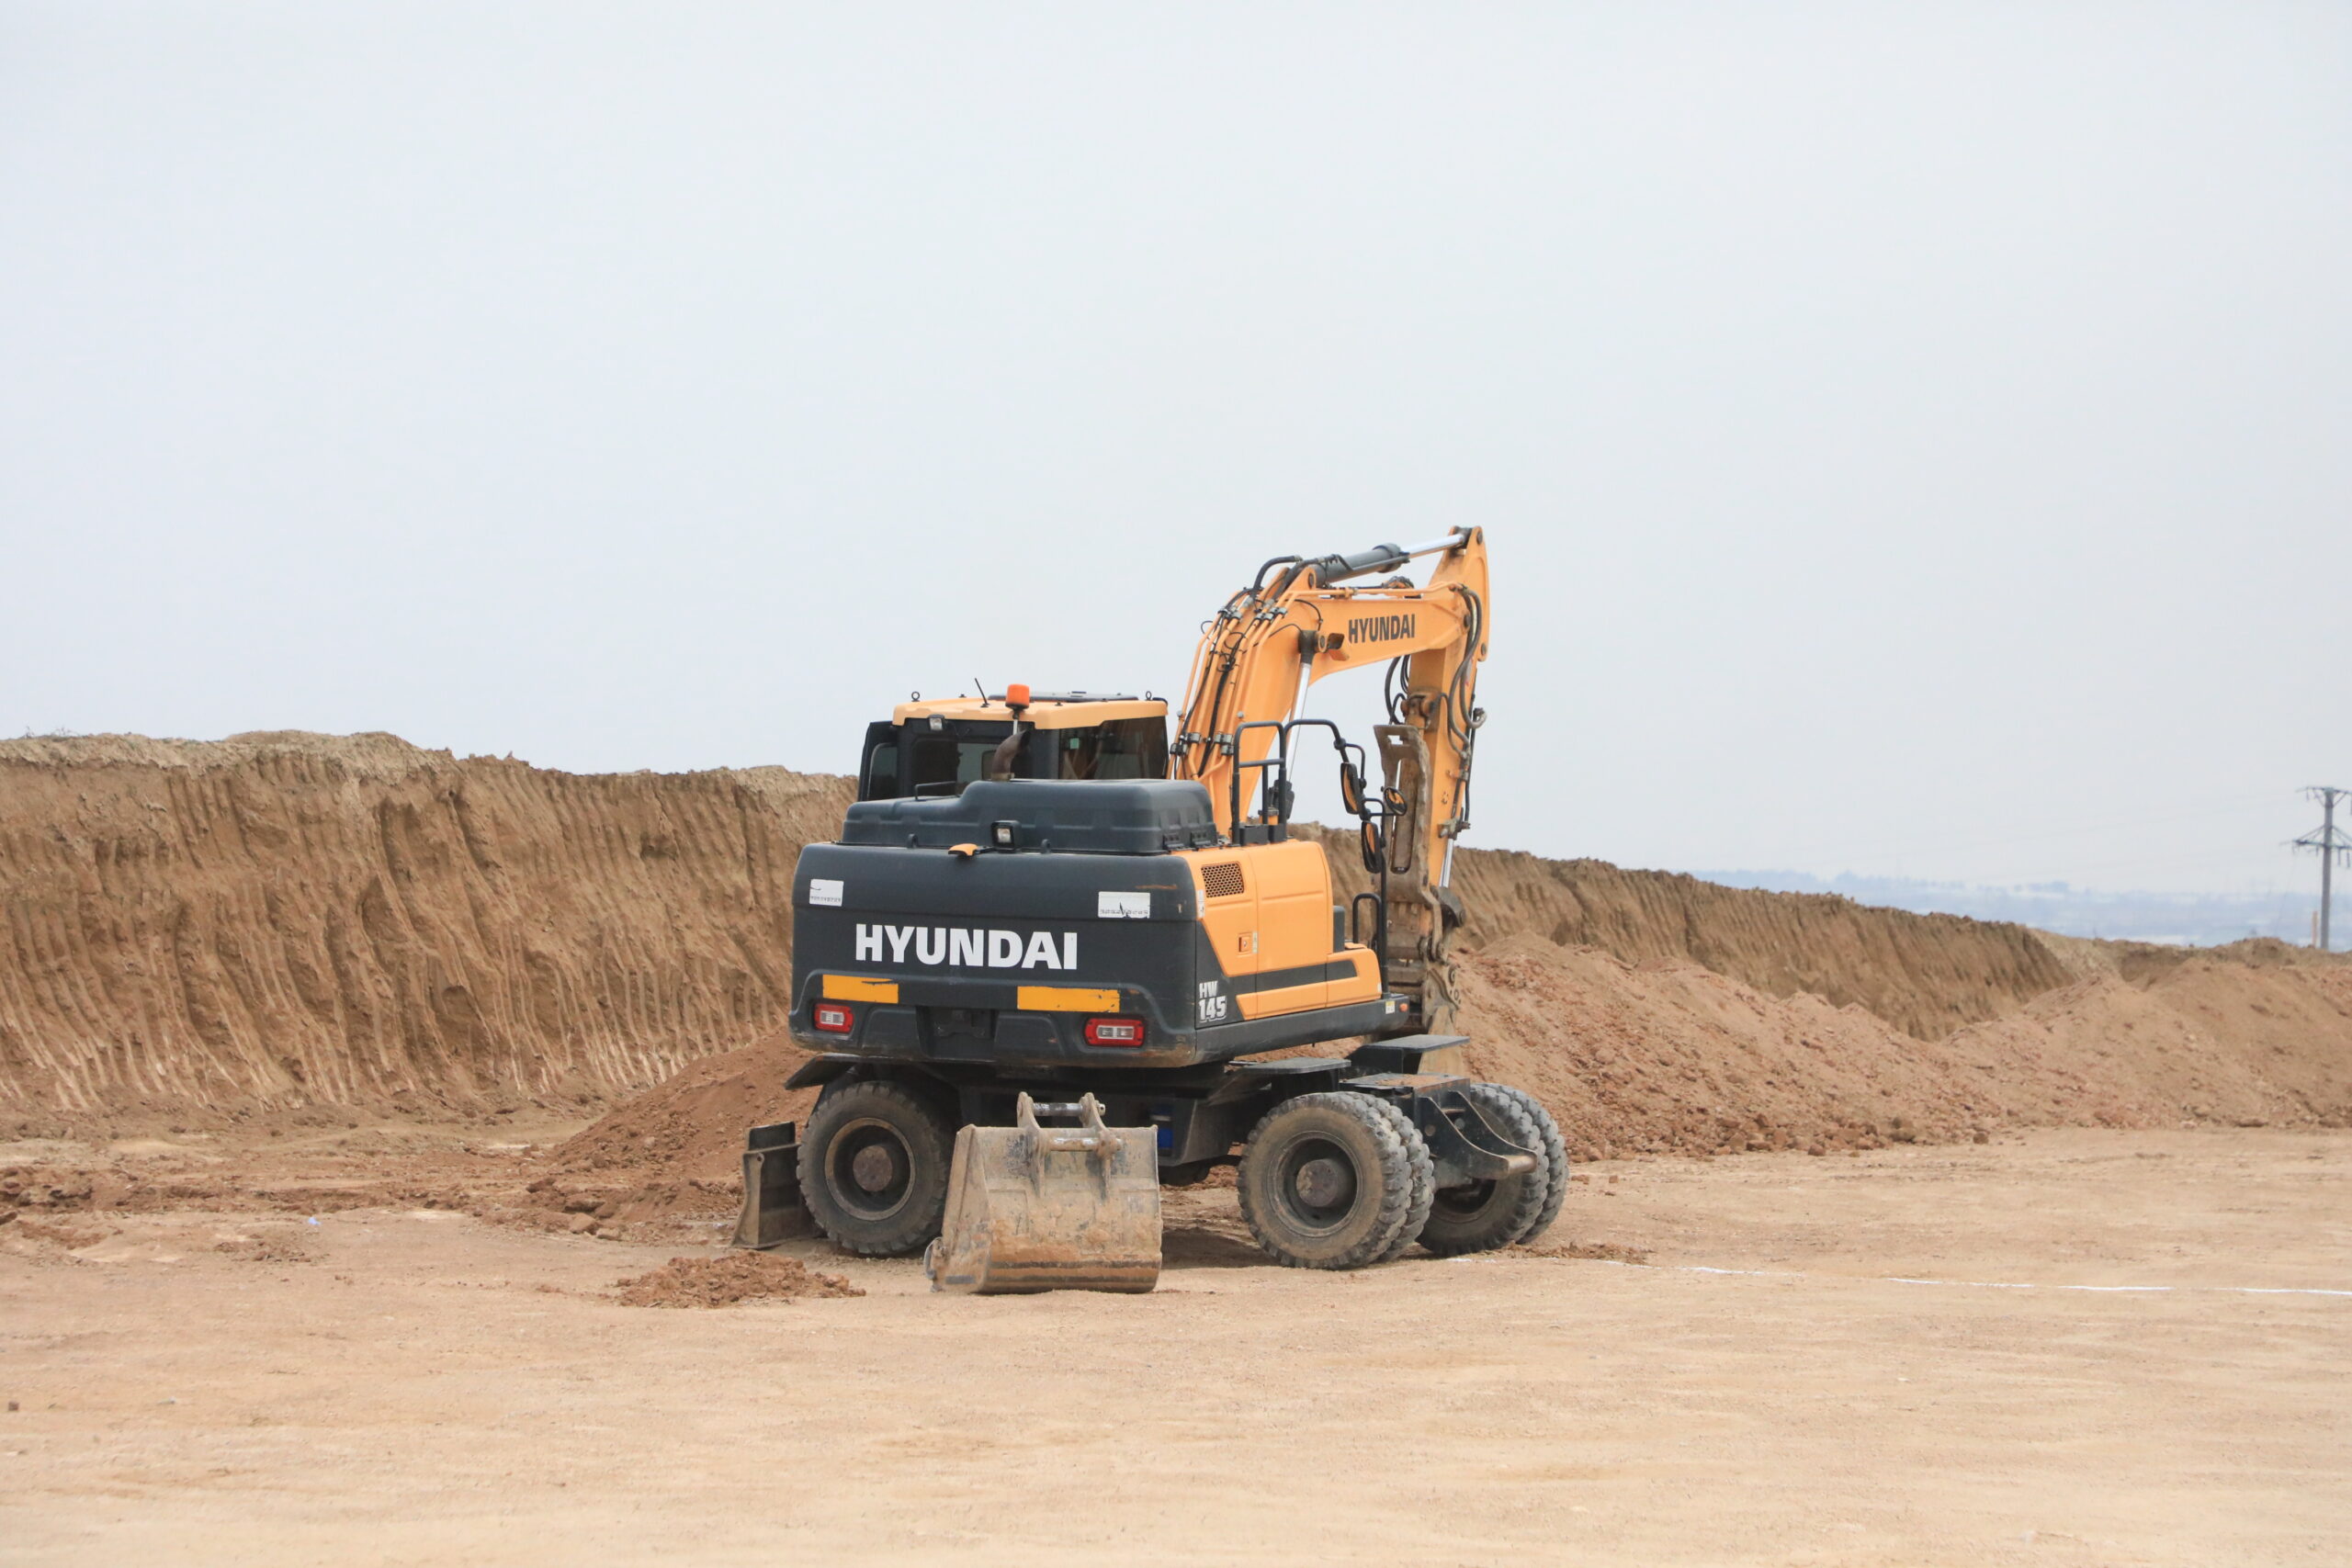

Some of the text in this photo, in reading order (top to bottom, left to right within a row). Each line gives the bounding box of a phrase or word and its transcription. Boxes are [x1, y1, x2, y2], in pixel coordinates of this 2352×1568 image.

[1348, 613, 1416, 644] HYUNDAI
[855, 923, 1078, 970] HYUNDAI
[1199, 980, 1218, 998] HW
[1199, 996, 1227, 1022] 145
